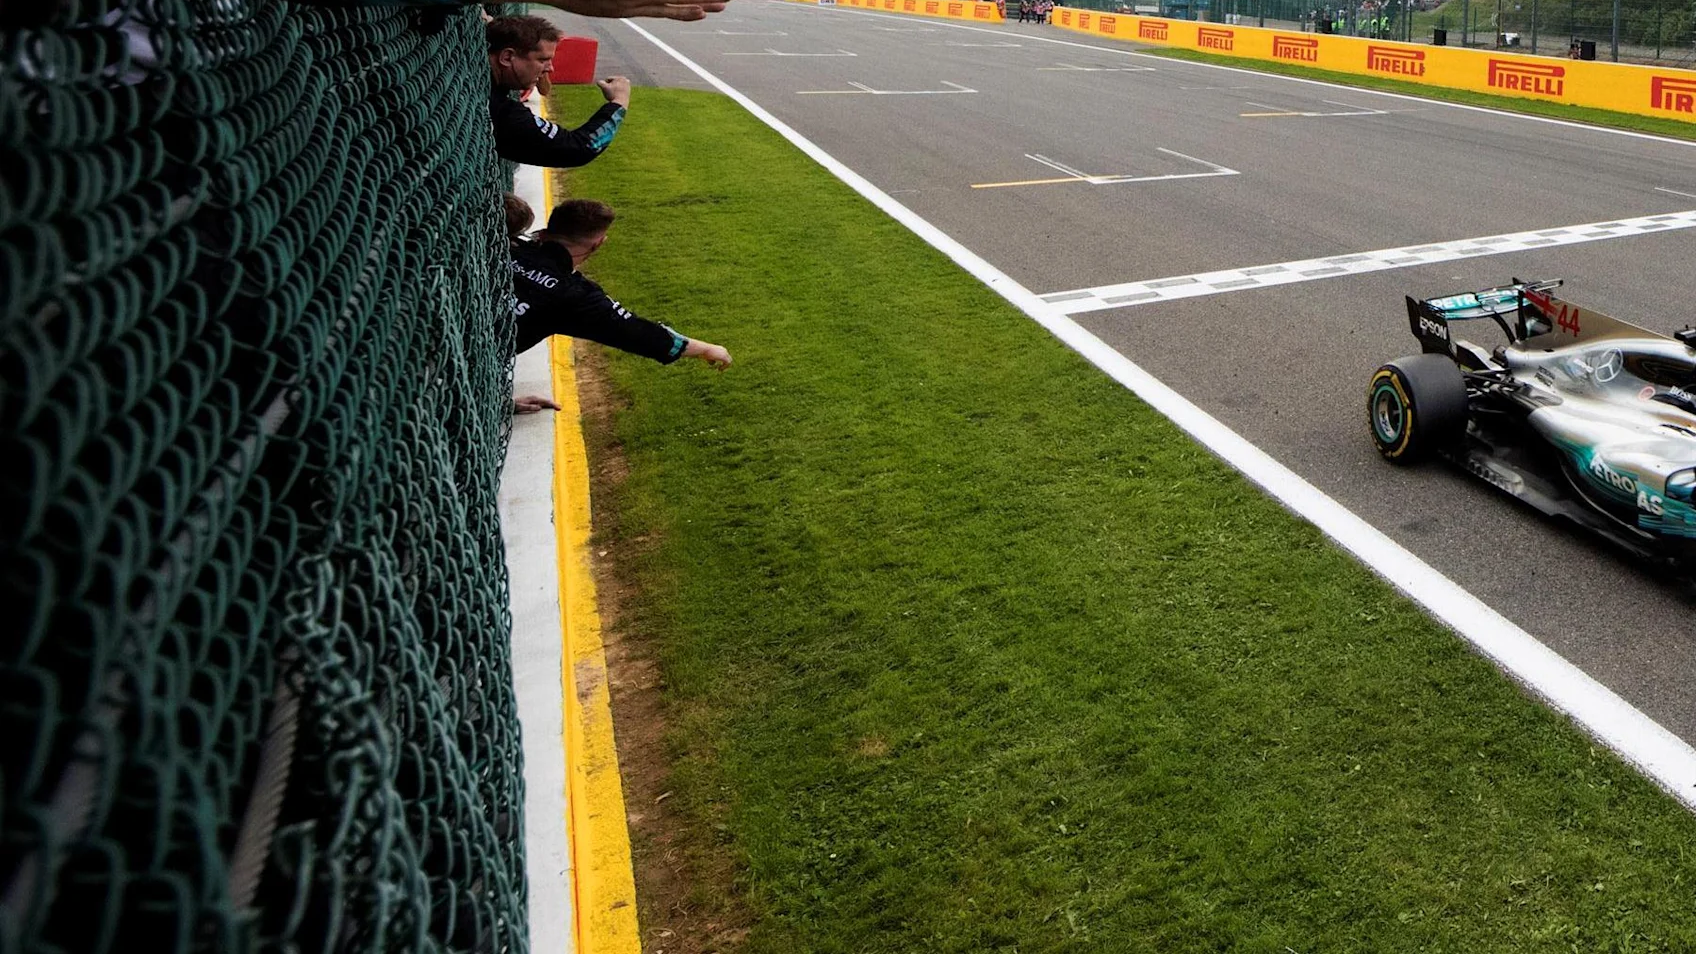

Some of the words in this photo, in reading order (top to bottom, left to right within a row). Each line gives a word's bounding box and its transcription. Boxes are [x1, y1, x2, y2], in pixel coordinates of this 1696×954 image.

[1139, 21, 1169, 41] PIRELLI
[1198, 27, 1235, 51] PIRELLI
[1272, 35, 1319, 62] PIRELLI
[1367, 45, 1426, 77] PIRELLI
[1488, 59, 1566, 97] PIRELLI
[1419, 317, 1448, 341] EPSON
[1557, 303, 1581, 338] 44
[1589, 452, 1665, 516] PETROAS
